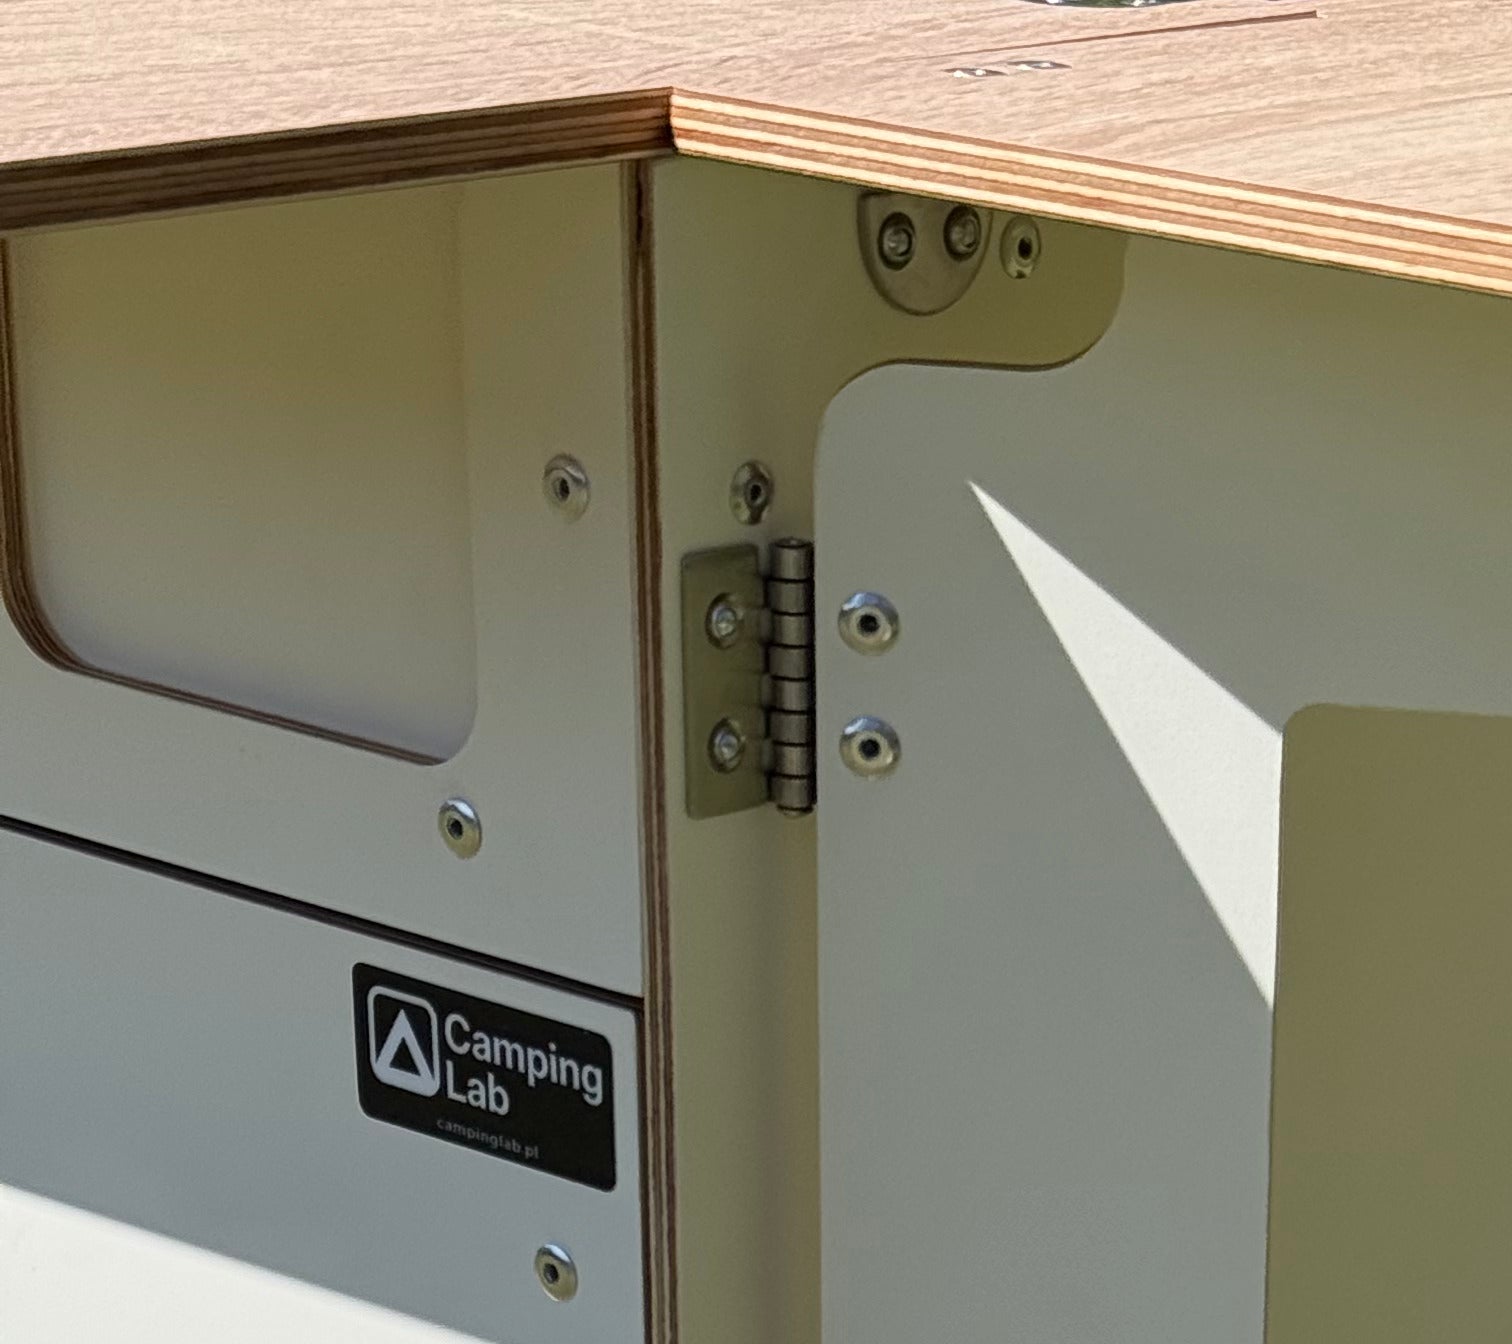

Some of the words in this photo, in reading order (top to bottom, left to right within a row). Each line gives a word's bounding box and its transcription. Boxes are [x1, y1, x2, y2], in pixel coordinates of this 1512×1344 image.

[444, 1013, 603, 1106] Camping
[446, 1060, 509, 1116] Lab
[436, 1118, 539, 1159] campinglab.pl
